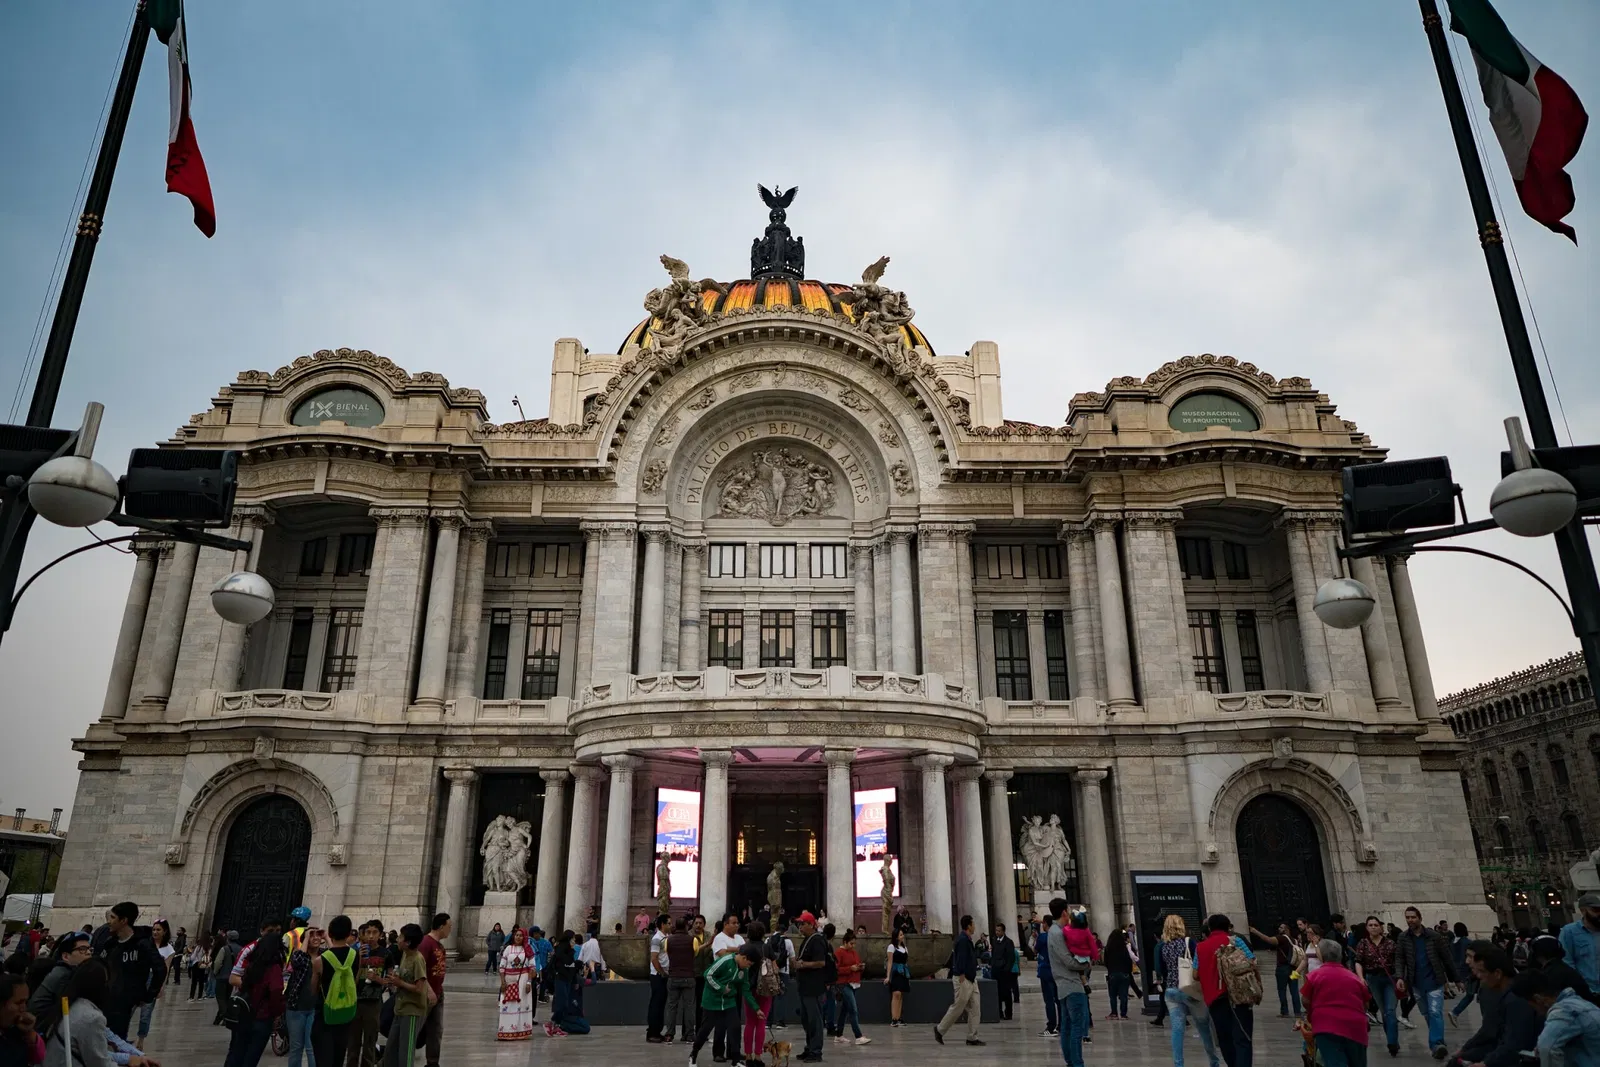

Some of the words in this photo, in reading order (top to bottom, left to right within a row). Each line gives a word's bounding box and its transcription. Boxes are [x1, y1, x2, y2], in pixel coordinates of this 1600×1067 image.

[309, 401, 334, 418] IX
[687, 441, 730, 503] PALACIO
[736, 426, 758, 442] DE
[768, 422, 835, 449] BELLAS
[838, 454, 869, 504] ARTES
